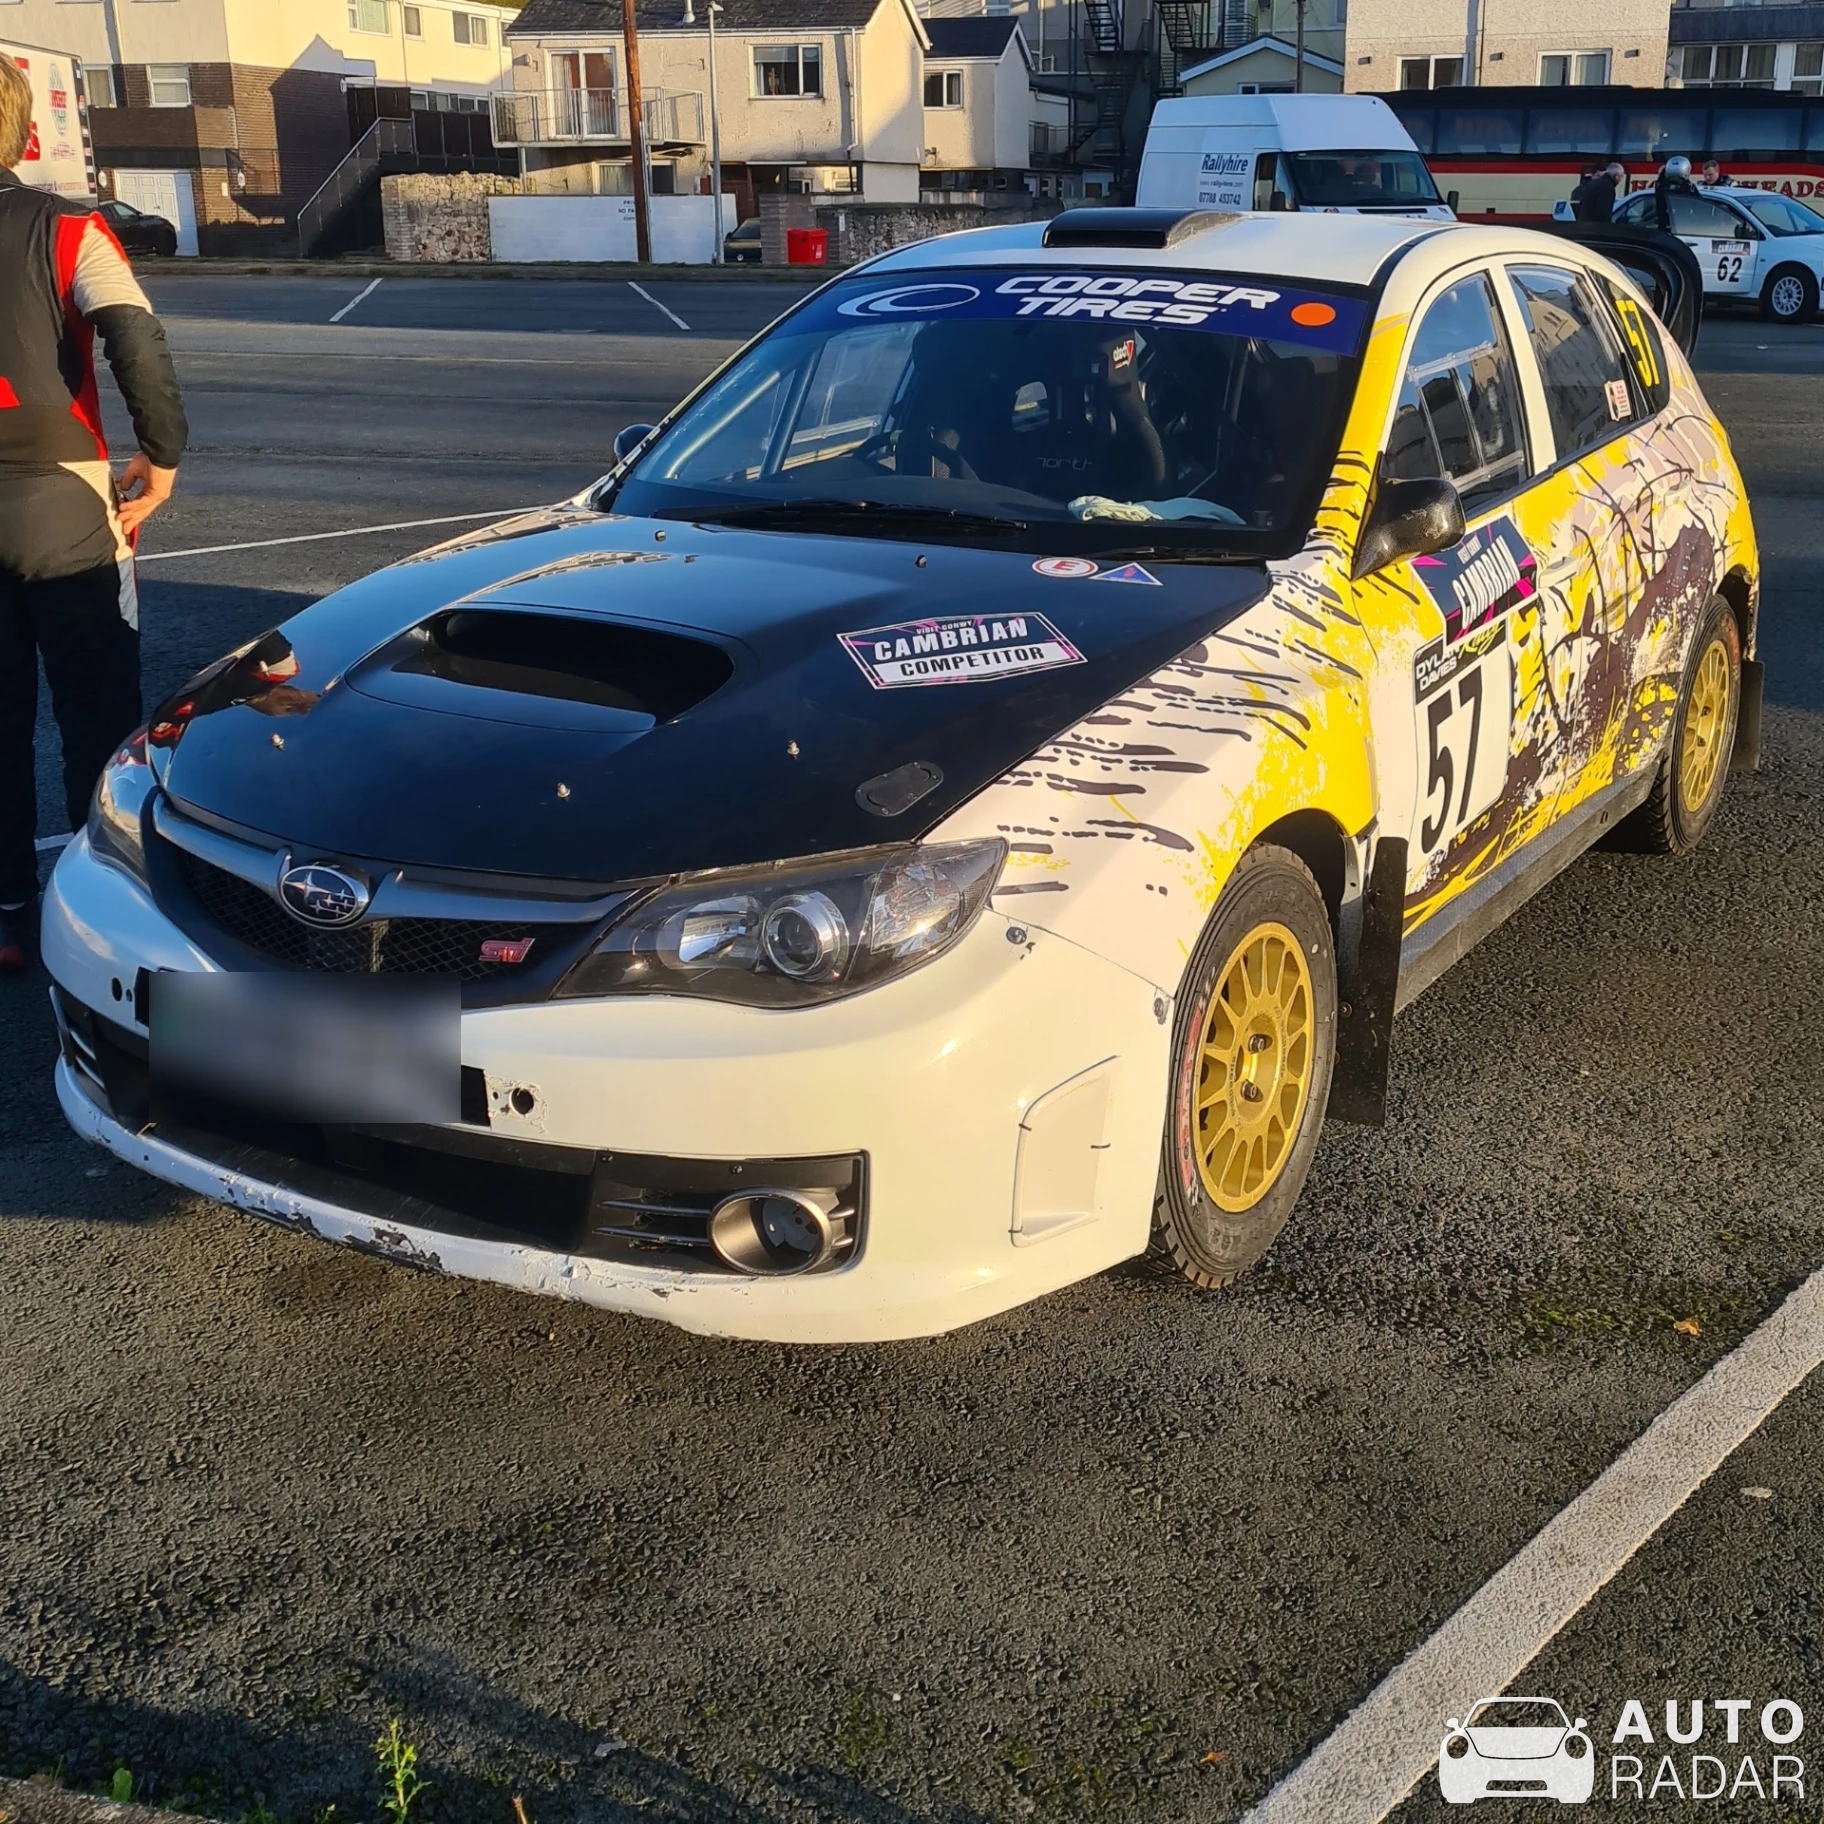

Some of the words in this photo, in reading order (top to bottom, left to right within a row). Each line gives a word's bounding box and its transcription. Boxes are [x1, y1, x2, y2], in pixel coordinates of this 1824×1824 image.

[1201, 154, 1249, 176] Rallyhire
[1717, 255, 1743, 283] 62
[995, 276, 1280, 309] COOPER
[1015, 296, 1219, 325] TIRES
[1051, 560, 1081, 572] E
[1452, 534, 1521, 630] CAMBRIAN
[874, 617, 1028, 661] CAMBRIAN
[916, 624, 939, 635] VISIT
[941, 619, 973, 632] CONWY
[900, 645, 1046, 677] COMPETITOR
[1415, 646, 1460, 680] DYLAN
[1420, 656, 1458, 692] DAVIES
[1421, 664, 1483, 855] 57
